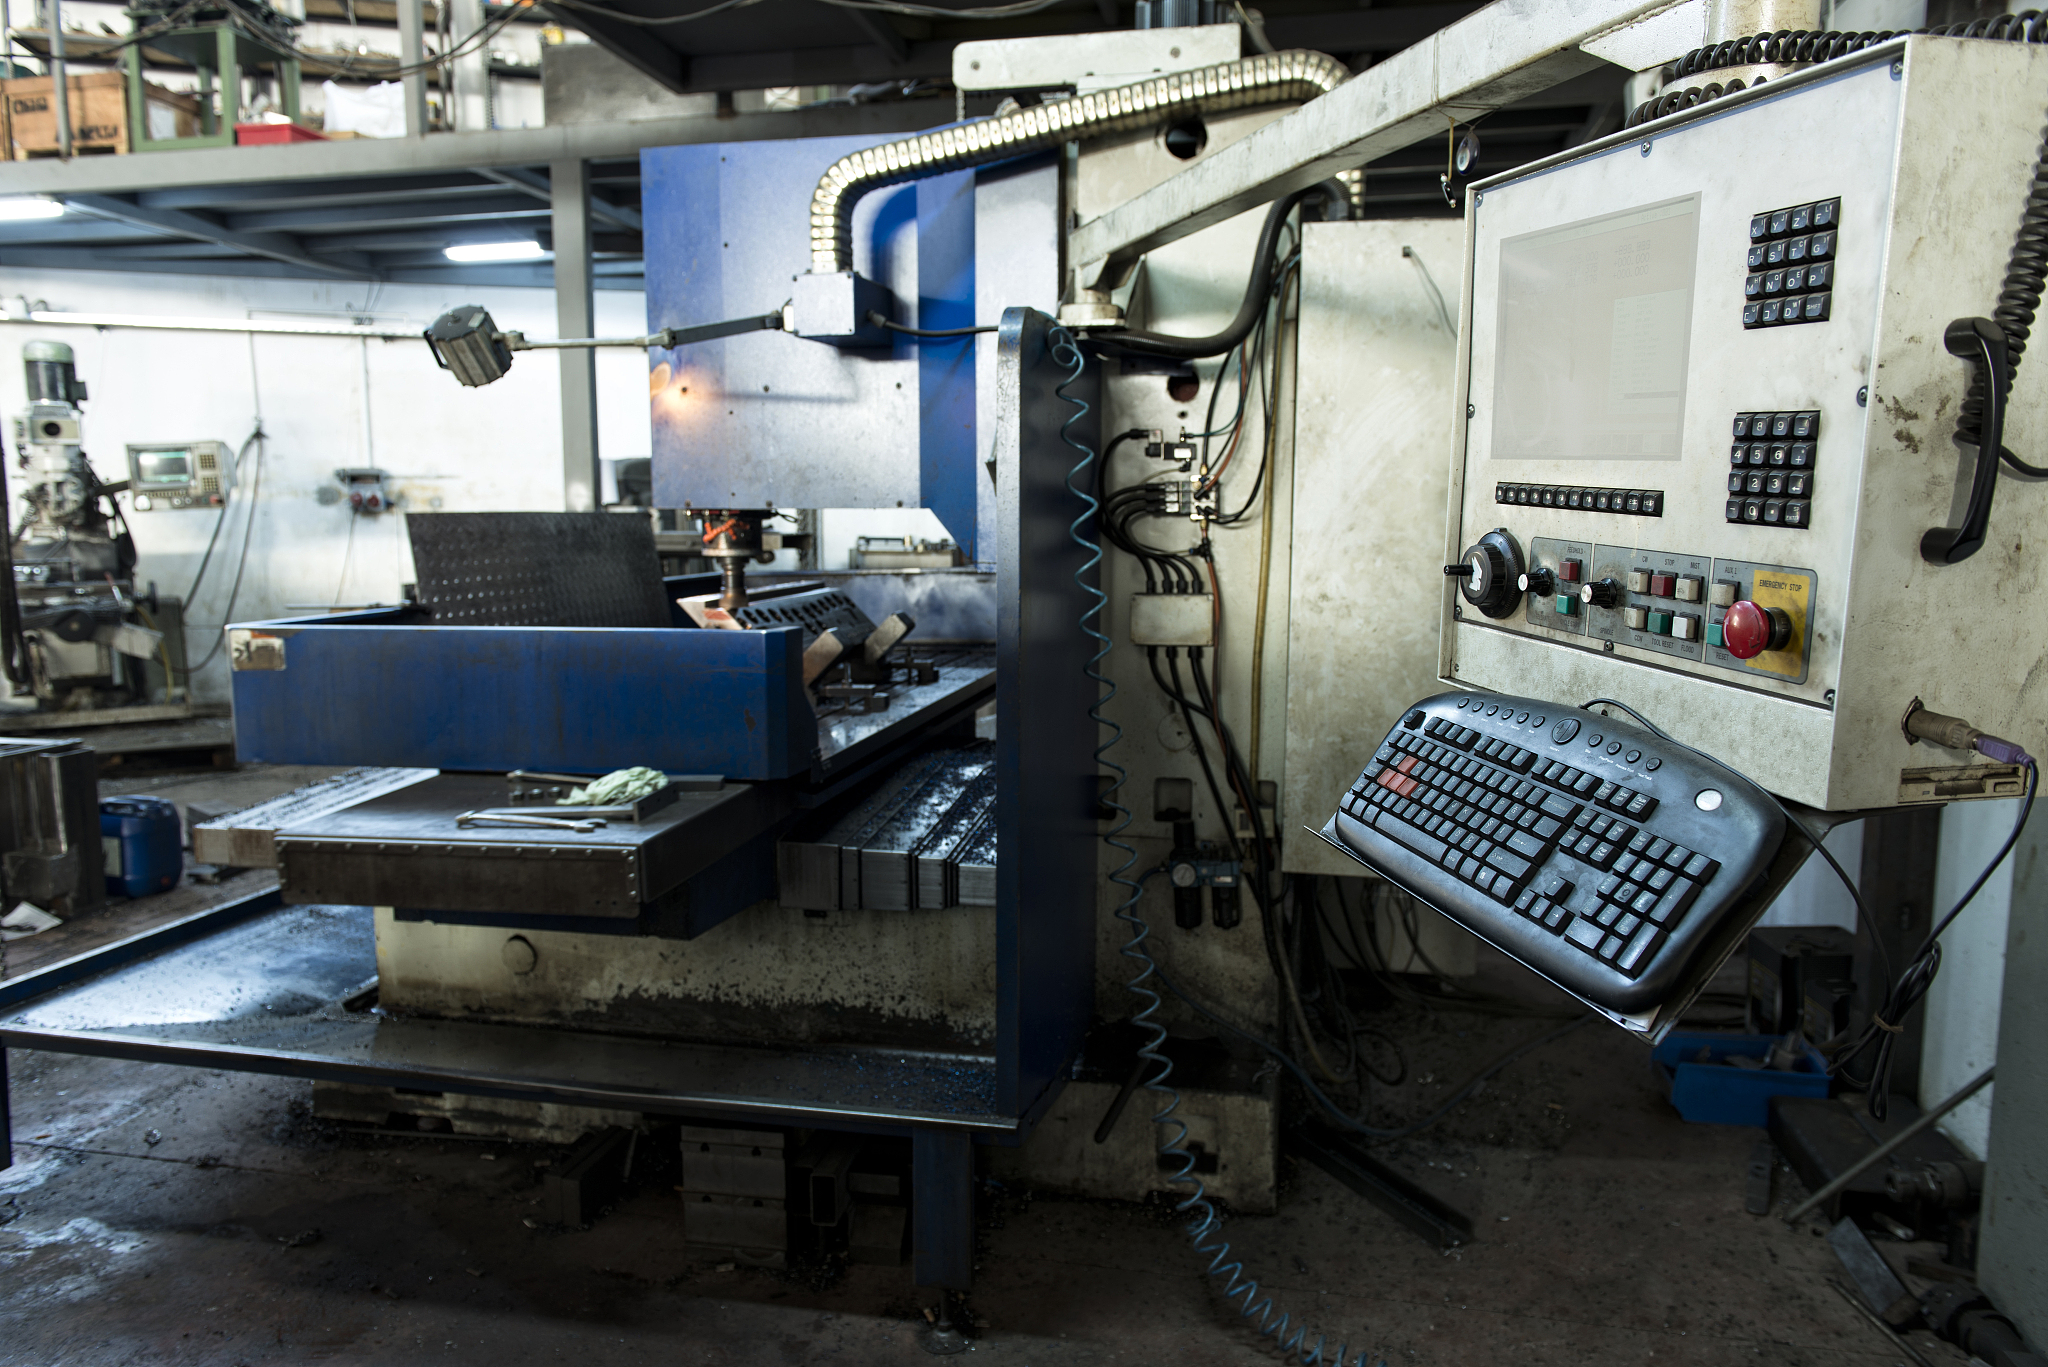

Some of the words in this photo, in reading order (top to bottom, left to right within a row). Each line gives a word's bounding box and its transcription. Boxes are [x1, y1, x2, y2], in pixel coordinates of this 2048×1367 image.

[1690, 562, 1701, 570] MIST
[1724, 566, 1734, 575] AUX
[1759, 579, 1788, 591] EMERGENCY
[1789, 584, 1802, 592] STOP
[1651, 638, 1661, 646] TOOL
[1661, 640, 1674, 649] RESET
[1681, 644, 1695, 654] FLOOD
[1715, 651, 1730, 661] RESET
